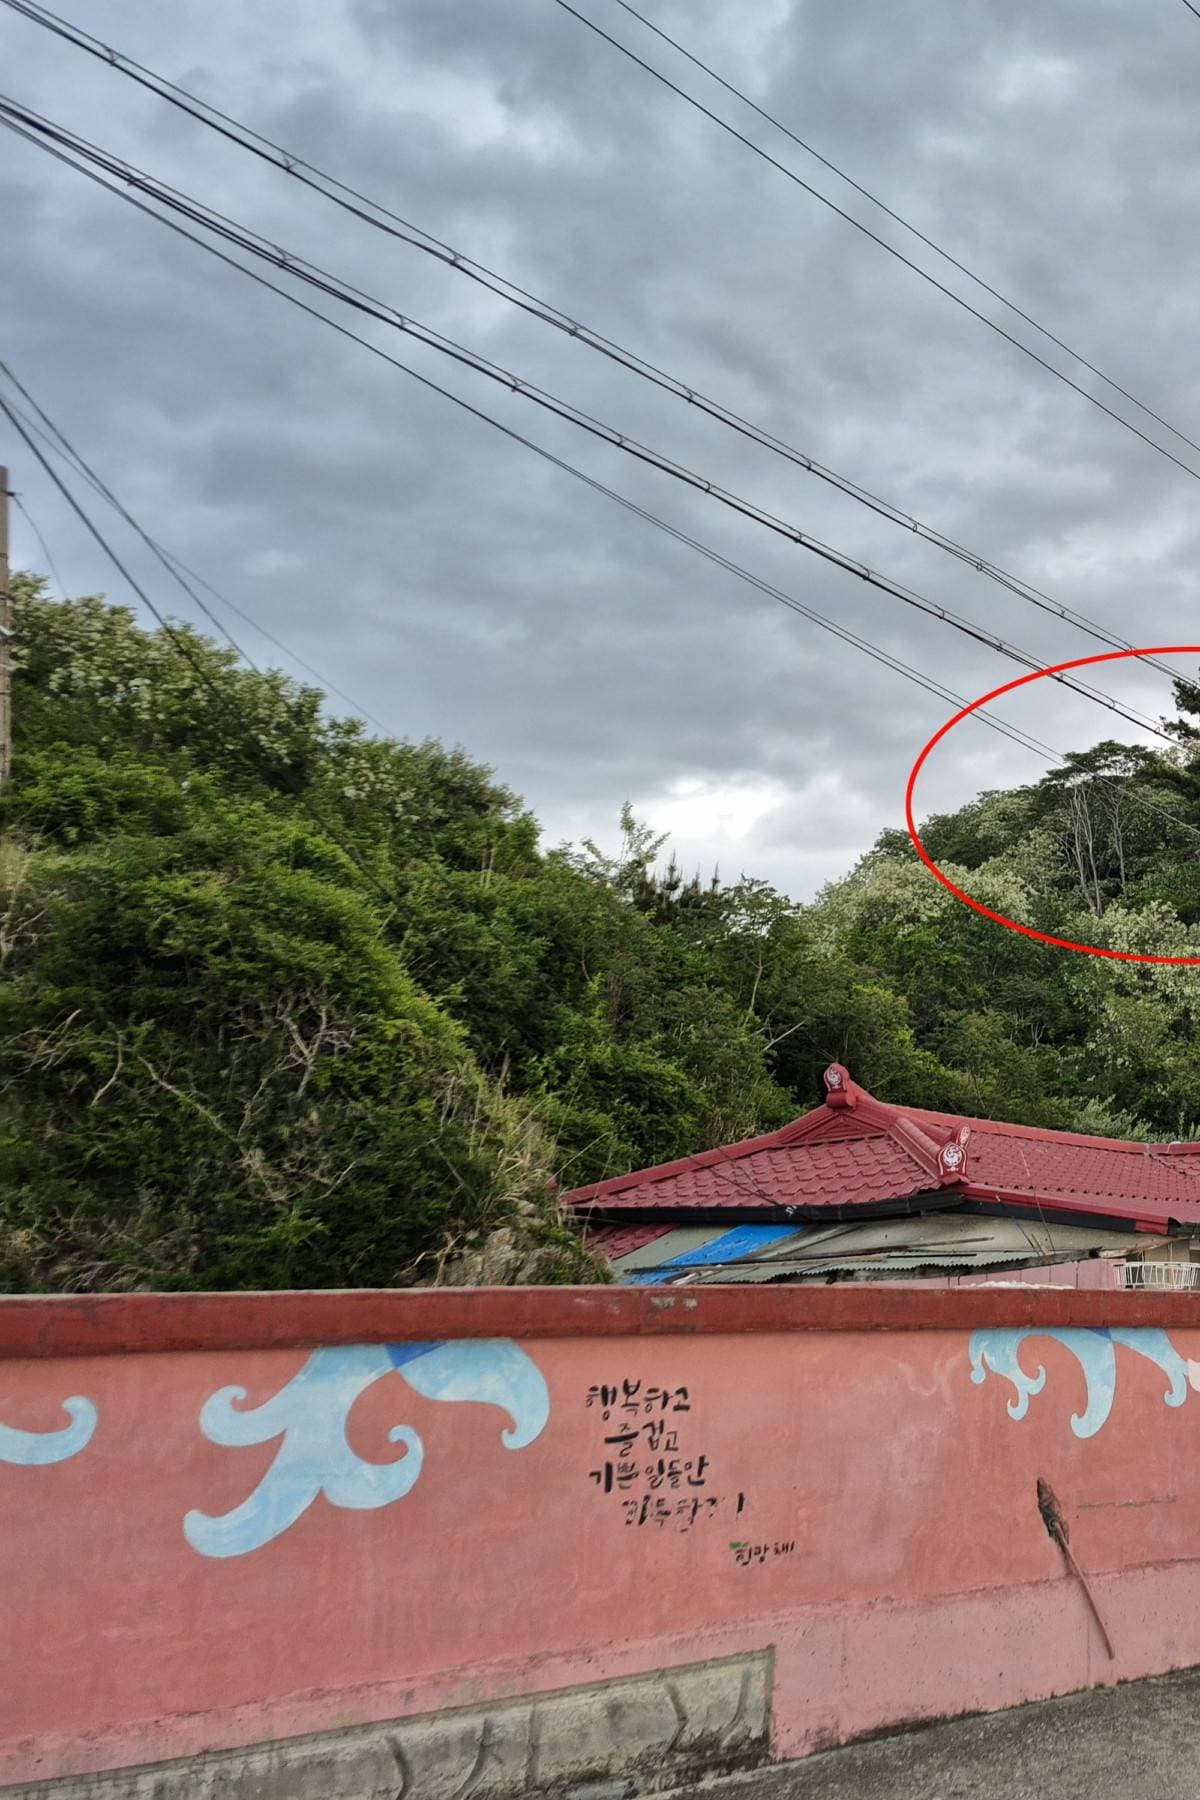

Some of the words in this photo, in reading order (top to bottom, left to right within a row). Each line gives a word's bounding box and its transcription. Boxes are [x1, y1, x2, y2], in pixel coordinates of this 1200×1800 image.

[586, 1378, 690, 1421] 행복하고
[604, 1419, 679, 1458] 즐겁고
[589, 1462, 639, 1493] 기쁜
[645, 1455, 709, 1489] 일들만
